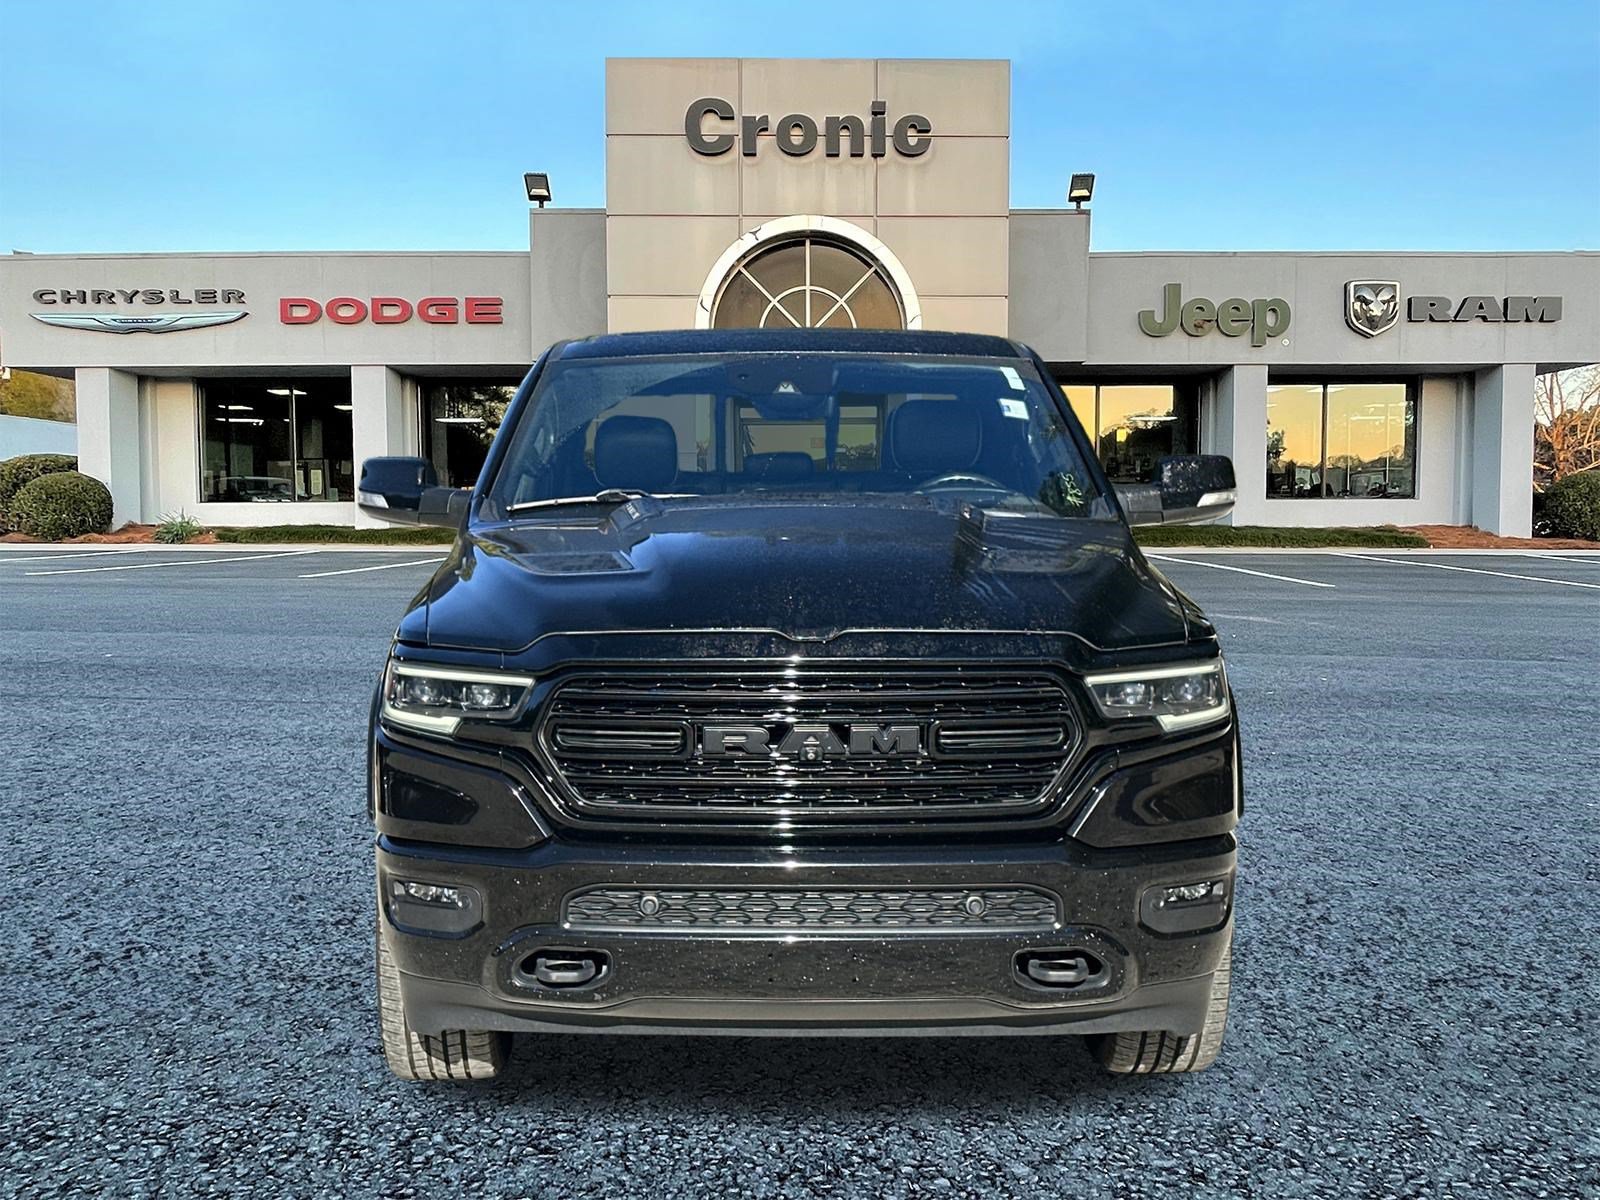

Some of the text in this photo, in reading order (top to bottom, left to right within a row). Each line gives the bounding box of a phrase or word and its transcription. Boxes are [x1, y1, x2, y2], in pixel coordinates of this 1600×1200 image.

[685, 97, 932, 157] Cronic
[32, 288, 247, 304] CHRYSLER
[1407, 296, 1563, 322] RAM
[280, 297, 503, 324] DODGE
[1138, 283, 1291, 347] Jeep
[703, 725, 921, 754] RAM
